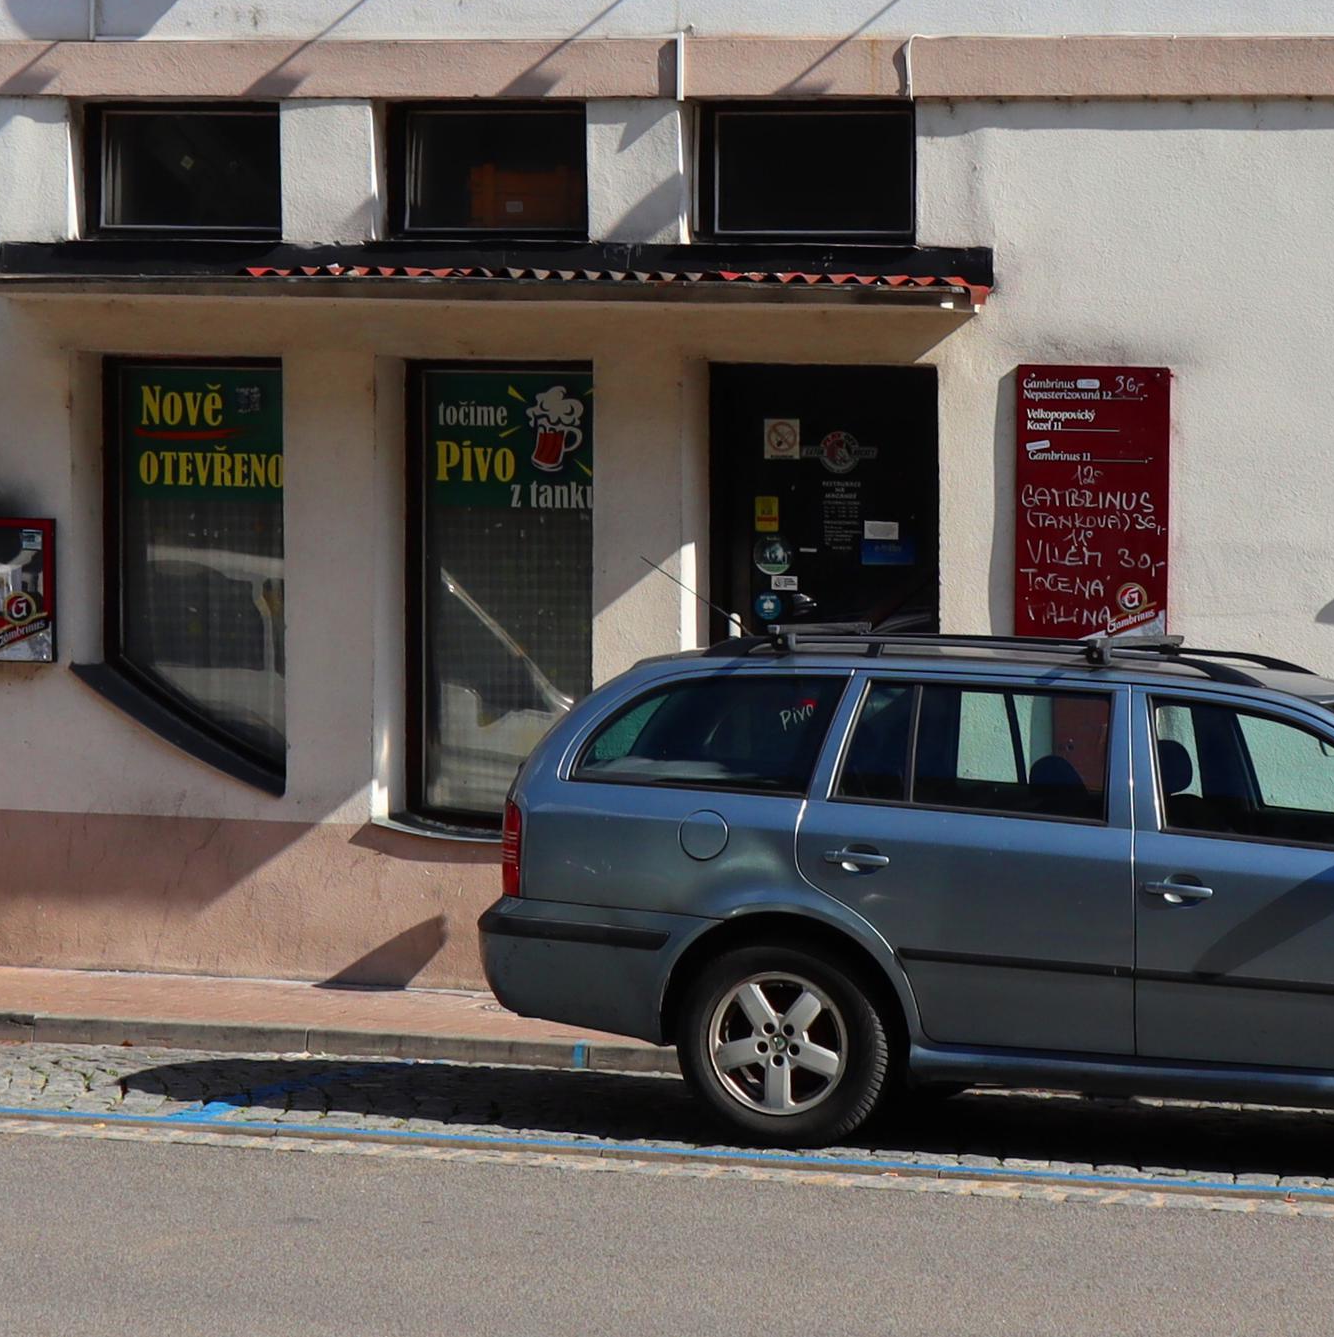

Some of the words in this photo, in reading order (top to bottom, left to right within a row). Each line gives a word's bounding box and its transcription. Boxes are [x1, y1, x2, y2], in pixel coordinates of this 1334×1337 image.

[1022, 378, 1076, 390] Gambrinus
[1102, 391, 1113, 400] 12
[140, 382, 224, 427] Nově
[437, 400, 508, 427] točíme
[1026, 408, 1096, 422] Velkopopovický
[1026, 421, 1052, 431] Kozel
[138, 444, 284, 489] OTEVŘENO
[1028, 450, 1081, 462] Gambrinus
[1082, 452, 1092, 462] 11
[510, 484, 524, 508] z
[1021, 484, 1155, 513] GAMBRINUS
[1107, 609, 1156, 634] Gambrinus
[779, 704, 814, 731] Pivo
